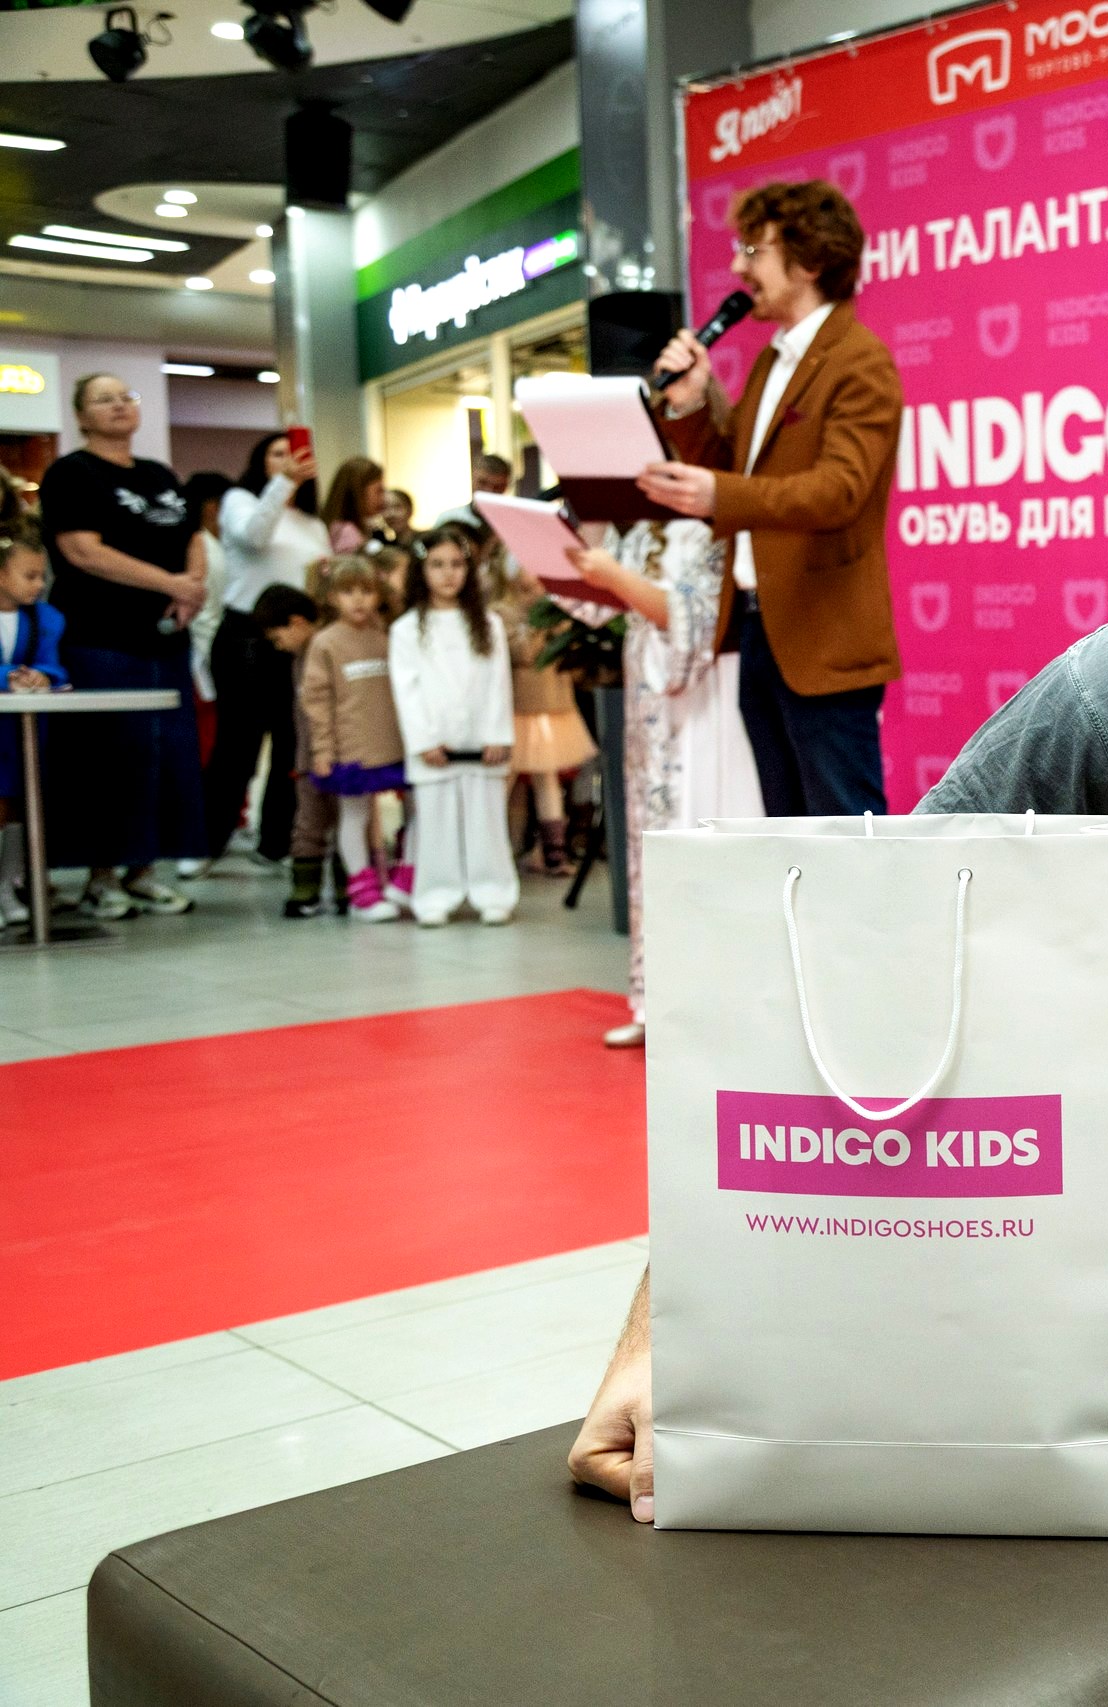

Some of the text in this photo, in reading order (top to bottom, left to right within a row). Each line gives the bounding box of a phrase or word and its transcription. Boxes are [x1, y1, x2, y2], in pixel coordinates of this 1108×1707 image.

[900, 502, 1011, 546] ОБУВЬ
[1017, 495, 1095, 549] ДЛЯ
[739, 1123, 1040, 1167] INDIGO KIDS
[745, 1213, 1035, 1239] WWW.INDIGOSHOES.RU
